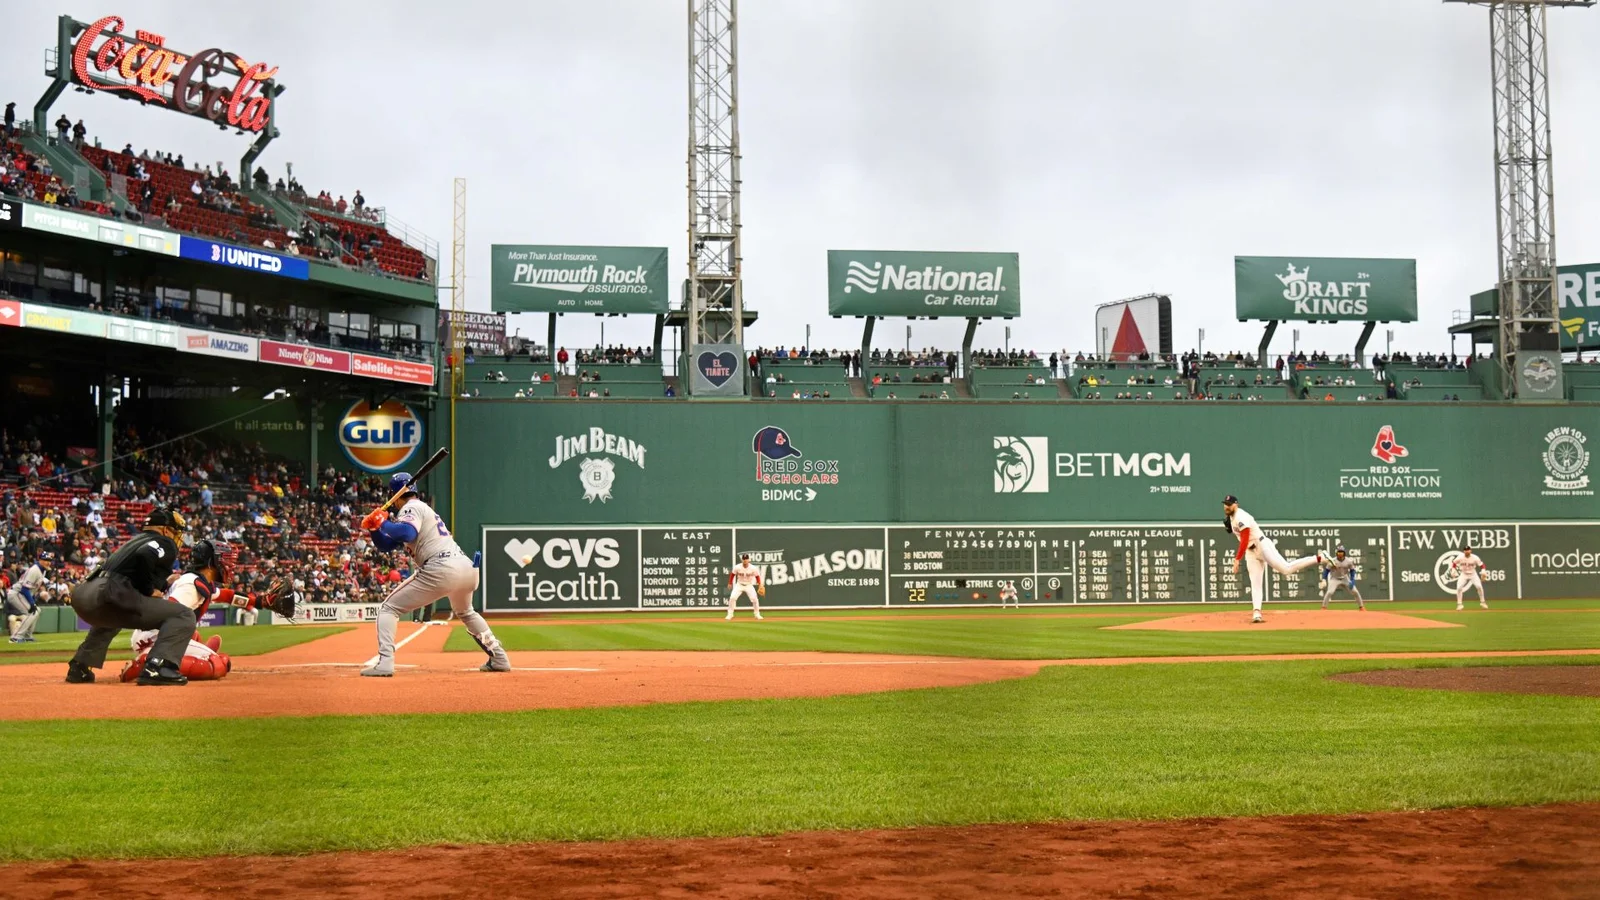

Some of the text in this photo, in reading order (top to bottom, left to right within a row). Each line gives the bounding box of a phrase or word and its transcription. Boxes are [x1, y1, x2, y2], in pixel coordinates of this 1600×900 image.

[136, 30, 165, 47] ENJOY
[227, 248, 282, 272] UNITED
[508, 251, 598, 262] More Than Just Insurance.
[513, 263, 648, 288] Plymouth Rock
[881, 265, 1003, 292] National
[1283, 280, 1371, 301] DRAFT
[924, 293, 999, 307] Car Rental
[1294, 298, 1369, 315] KINGS
[211, 338, 249, 354] AMAZING
[278, 348, 302, 360] Ninety
[316, 355, 333, 365] Nine
[354, 359, 394, 375] Safelite
[712, 359, 723, 368] EL
[261, 421, 296, 432] starts
[342, 420, 416, 444] Gulf
[1544, 426, 1570, 443] IBEW
[549, 426, 647, 469] JIM BEAM
[762, 460, 839, 473] RED SOX
[1055, 452, 1191, 477] BETMGM
[1370, 466, 1411, 474] RED SOX
[593, 471, 602, 481] B
[762, 473, 839, 485] SCHOLARS
[1340, 475, 1440, 488] FOUNDATION
[762, 489, 803, 501] BIDMC
[663, 532, 711, 540] AL EAST
[925, 530, 1036, 538] FENWAY PARK
[1089, 530, 1183, 538] AMERICAN LEAGUE
[1264, 529, 1340, 537] TIONAL LEAGUE
[904, 540, 910, 548] P
[953, 540, 959, 548] 2
[961, 540, 967, 548] 3
[971, 540, 978, 548] 4
[980, 540, 986, 548] 5
[987, 540, 994, 548] 6
[999, 540, 1004, 548] 7
[1006, 540, 1012, 548] 8
[1014, 540, 1020, 548] 9
[1024, 540, 1032, 548] 10
[1040, 540, 1046, 548] R
[1052, 540, 1058, 548] H
[1063, 540, 1069, 548] E
[1188, 539, 1194, 547] R
[1397, 529, 1511, 550] F.W. WEBB
[542, 537, 620, 569] CVS
[764, 551, 784, 562] BUT
[1092, 550, 1169, 558] SEA 6 LAA
[1224, 549, 1235, 557] AZ
[1285, 549, 1300, 557] BAL
[643, 557, 707, 565] NEW YORK 28 19
[913, 562, 943, 570] BOSTON
[1091, 558, 1169, 566] CWS 5 ATH
[643, 567, 718, 576] BOSTON 25 25 4
[1092, 567, 1169, 575] CLE 5 TEX
[1401, 570, 1431, 583] Since
[643, 577, 719, 586] TORONTO 23 24 5
[827, 578, 880, 587] SINCE 1898
[1093, 575, 1170, 583] MIN NYY
[1222, 574, 1300, 582] COL STL
[508, 571, 621, 602] Health
[904, 581, 914, 589] AT
[916, 581, 929, 589] BAT
[936, 580, 957, 589] BALL
[966, 580, 993, 588] STRIKE
[1223, 582, 1299, 590] ATL KC
[643, 587, 719, 596] TAMPA BAY 23 26 6
[909, 589, 925, 602] 22
[1096, 592, 1170, 600] TB TOR
[1222, 591, 1240, 599] WSH
[643, 597, 720, 606] BALTIMORE 16 32 12
[313, 607, 338, 618] TRULY
